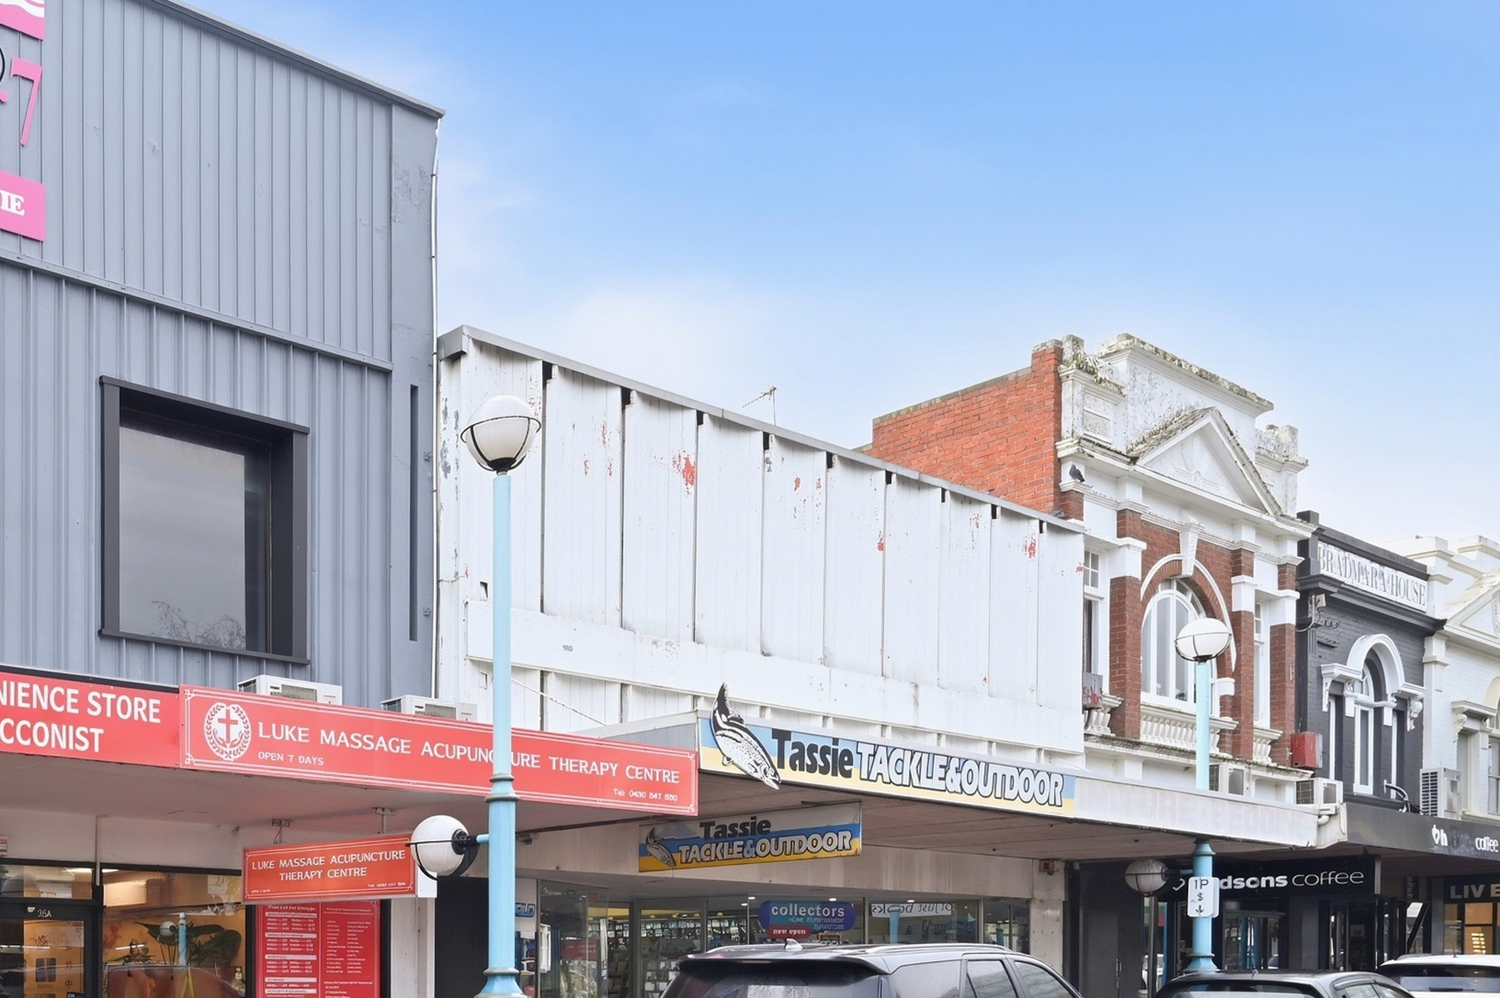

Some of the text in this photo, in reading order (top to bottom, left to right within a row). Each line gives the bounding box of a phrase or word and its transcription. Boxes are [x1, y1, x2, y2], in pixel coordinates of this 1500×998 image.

[1390, 574, 1426, 606] HOUSE
[86, 691, 161, 723] STORE
[258, 722, 680, 784] LUKE MASSAGE ACUPUNURE THERAPY CENTRE
[258, 751, 325, 766] OPEN 7 DAYS
[771, 728, 1064, 807] Tassie TACKLE&OUTDOOR
[700, 816, 771, 840] Tassie
[679, 830, 853, 864] TACKLE&OUTDOOR
[1475, 836, 1499, 852] coffee
[252, 850, 406, 870] LUKE MASSAGE ACUPUNCTURE
[279, 867, 368, 881] THERAPY CENTRE
[1219, 870, 1364, 890] dsons coffee
[1194, 879, 1209, 890] 1P
[771, 903, 845, 917] collectors
